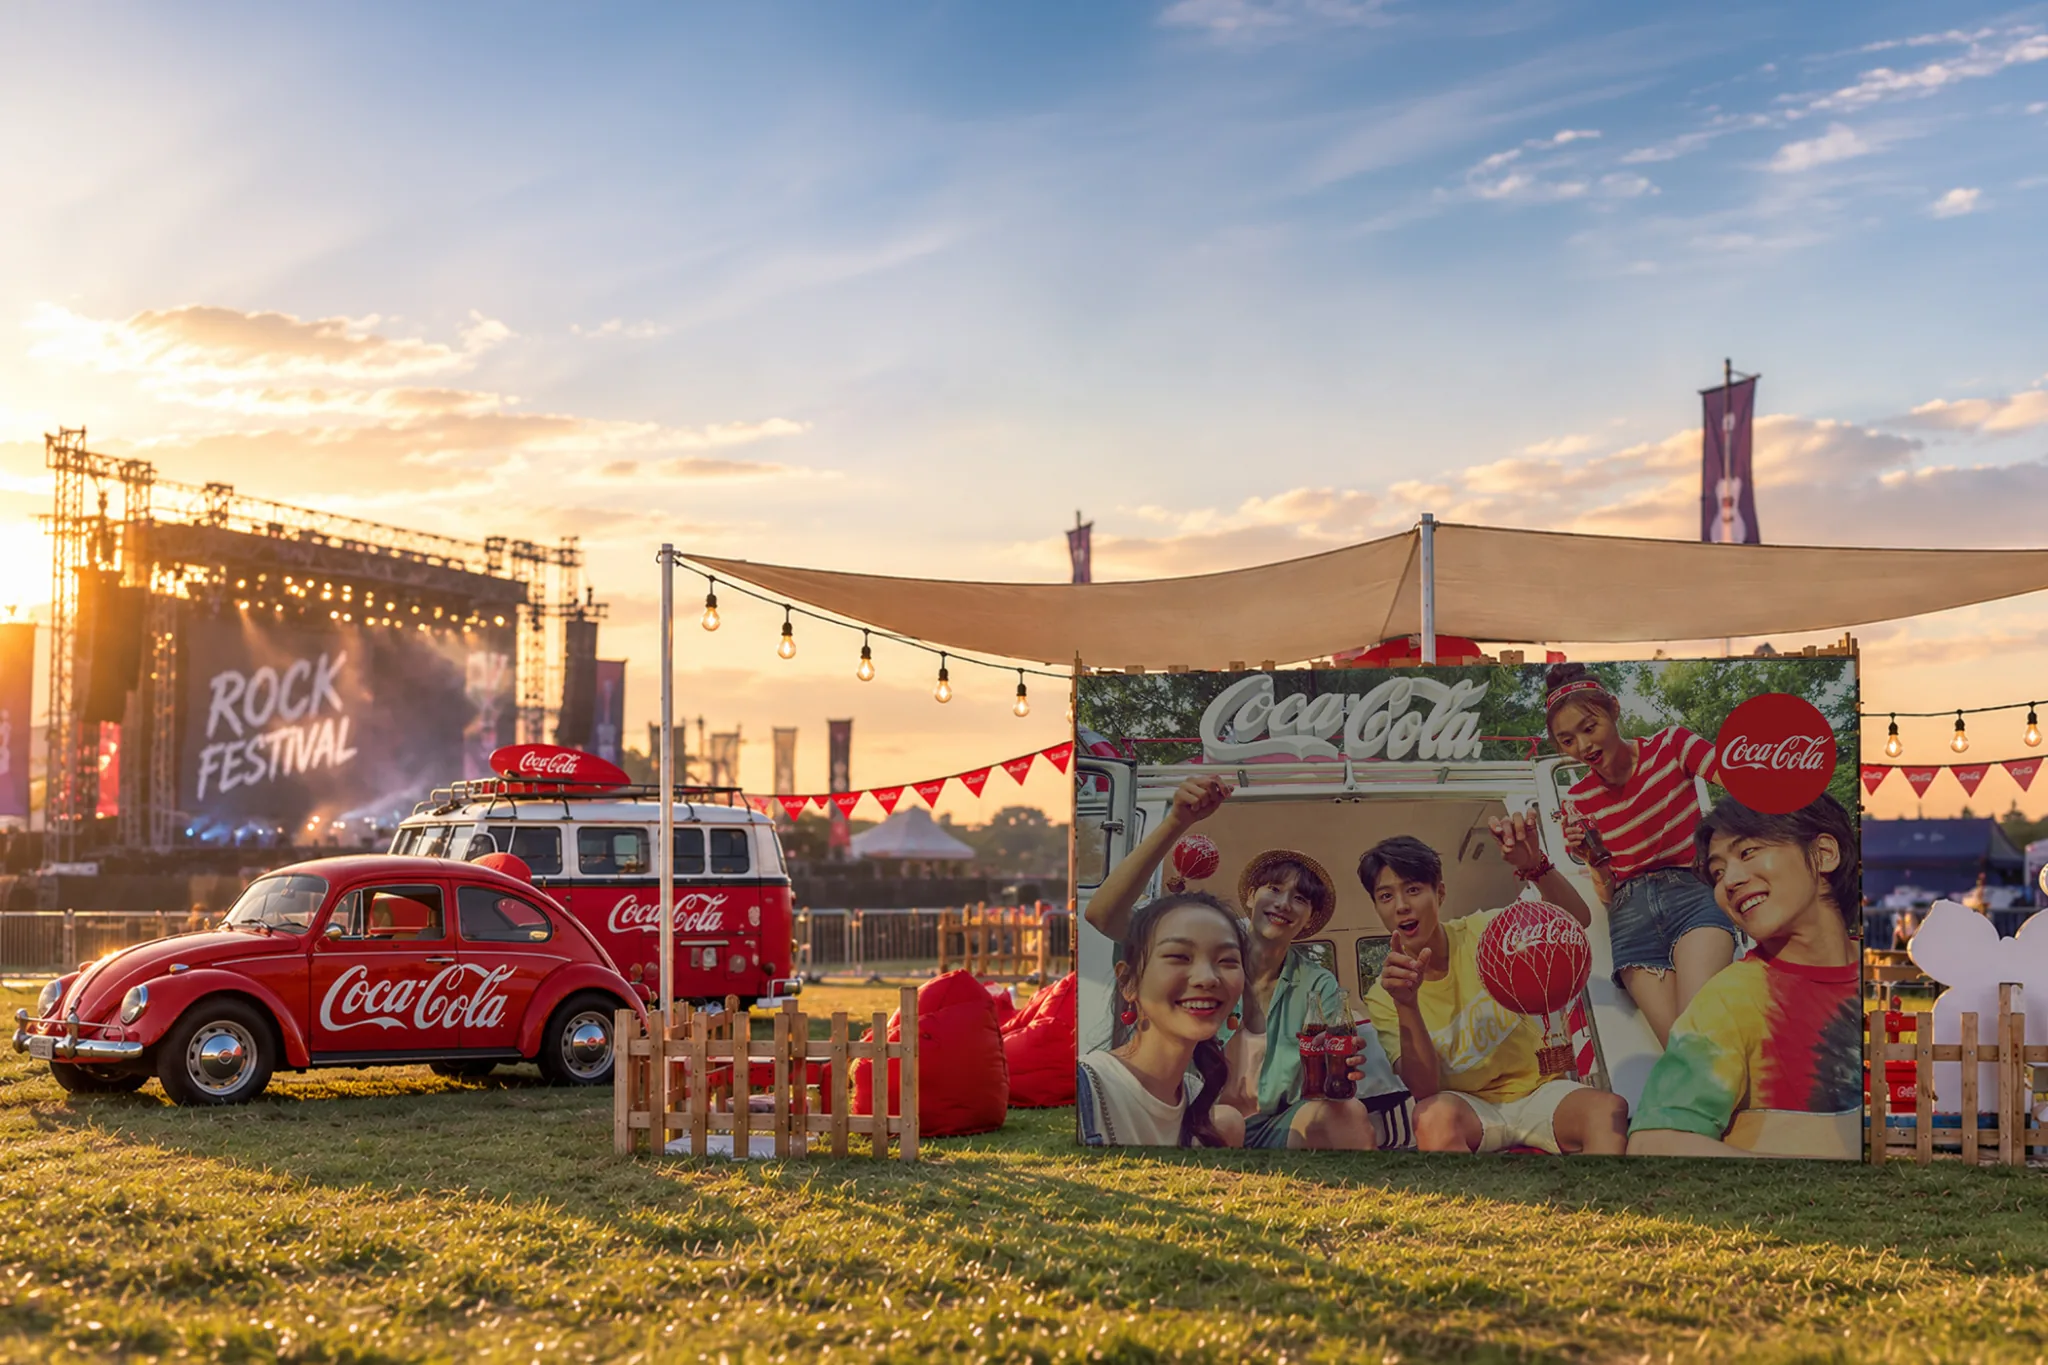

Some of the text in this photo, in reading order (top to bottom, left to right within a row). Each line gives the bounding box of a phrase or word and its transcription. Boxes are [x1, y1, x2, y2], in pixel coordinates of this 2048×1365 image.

[206, 650, 347, 738] ROCK
[1200, 674, 1489, 761] Coca-Cola
[197, 714, 358, 801] FESTIVAL
[1721, 735, 1831, 770] Coca-Cola
[608, 893, 729, 934] CocaCola
[319, 963, 518, 1031] Coca-Cola
